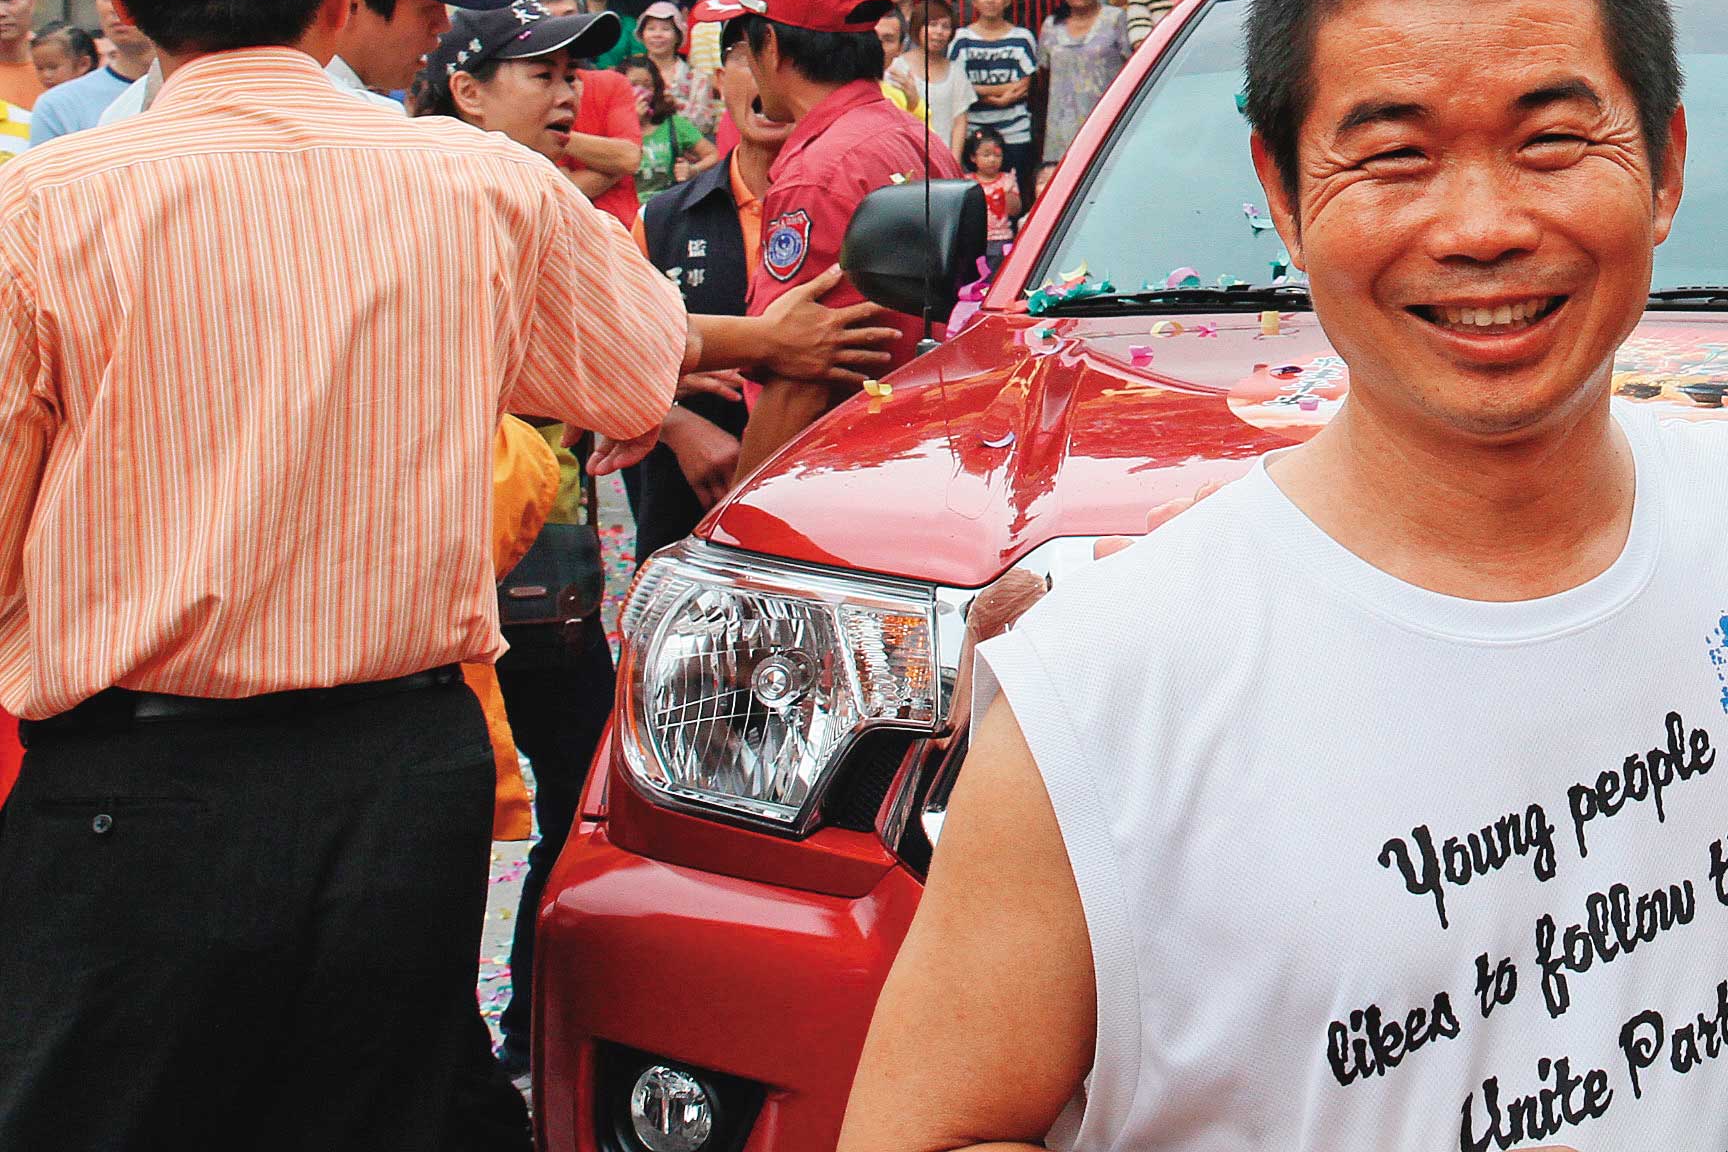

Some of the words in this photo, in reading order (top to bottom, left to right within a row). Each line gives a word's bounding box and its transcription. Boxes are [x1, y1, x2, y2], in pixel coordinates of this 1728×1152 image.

[1378, 803, 1556, 929] Young
[1567, 710, 1716, 857] people
[1326, 991, 1460, 1087] likes
[1474, 951, 1518, 1019] to
[1535, 879, 1695, 1020] follow
[1460, 1056, 1614, 1152] Unite
